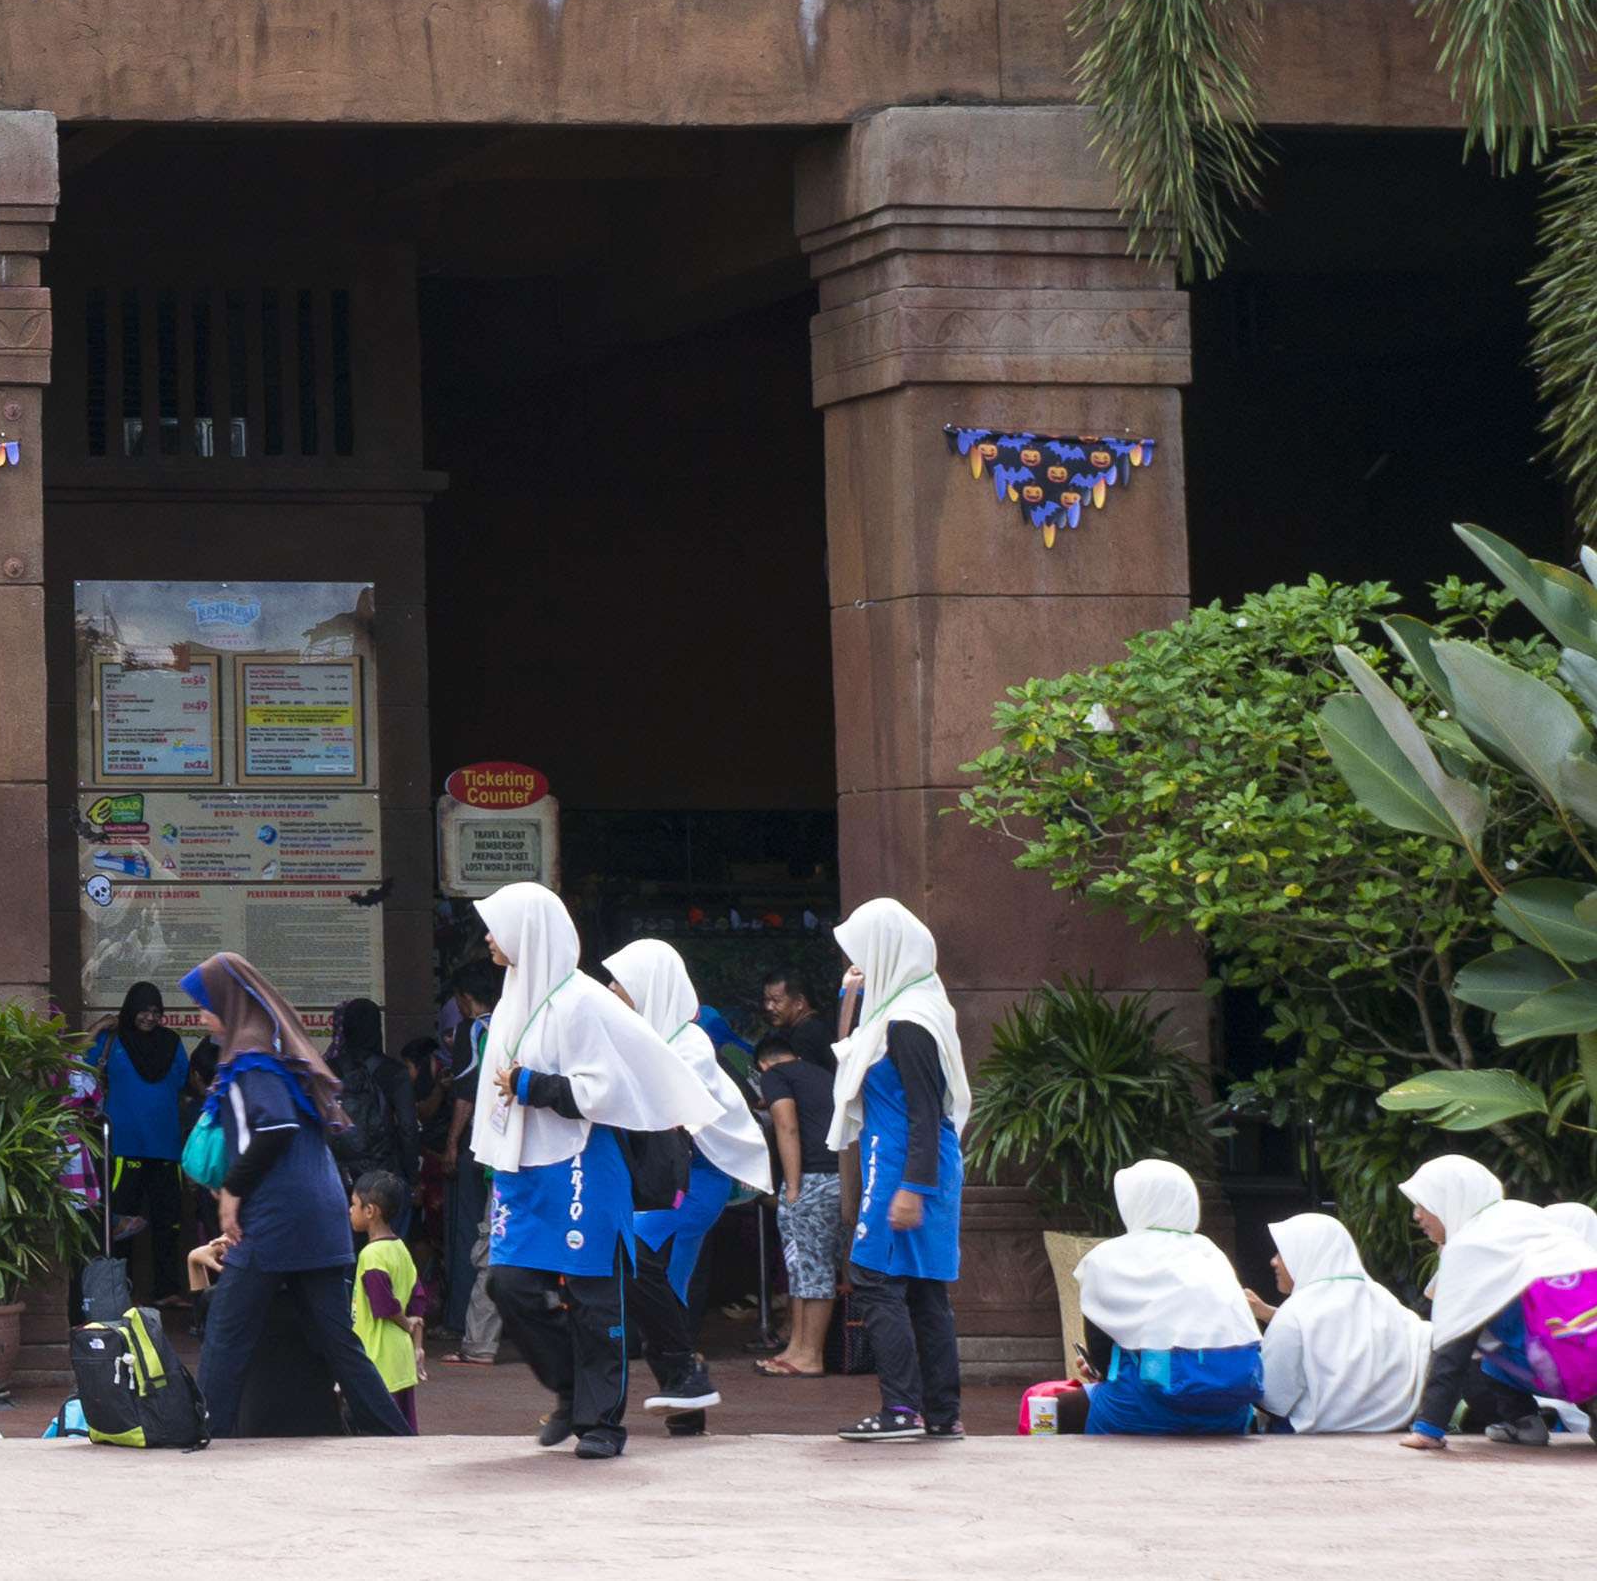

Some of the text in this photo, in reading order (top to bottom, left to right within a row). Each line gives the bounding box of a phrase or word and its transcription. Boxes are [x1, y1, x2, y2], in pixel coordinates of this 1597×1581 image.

[462, 770, 534, 792] Ticketing
[467, 787, 533, 804] Counter
[569, 1154, 583, 1221] ARIQ
